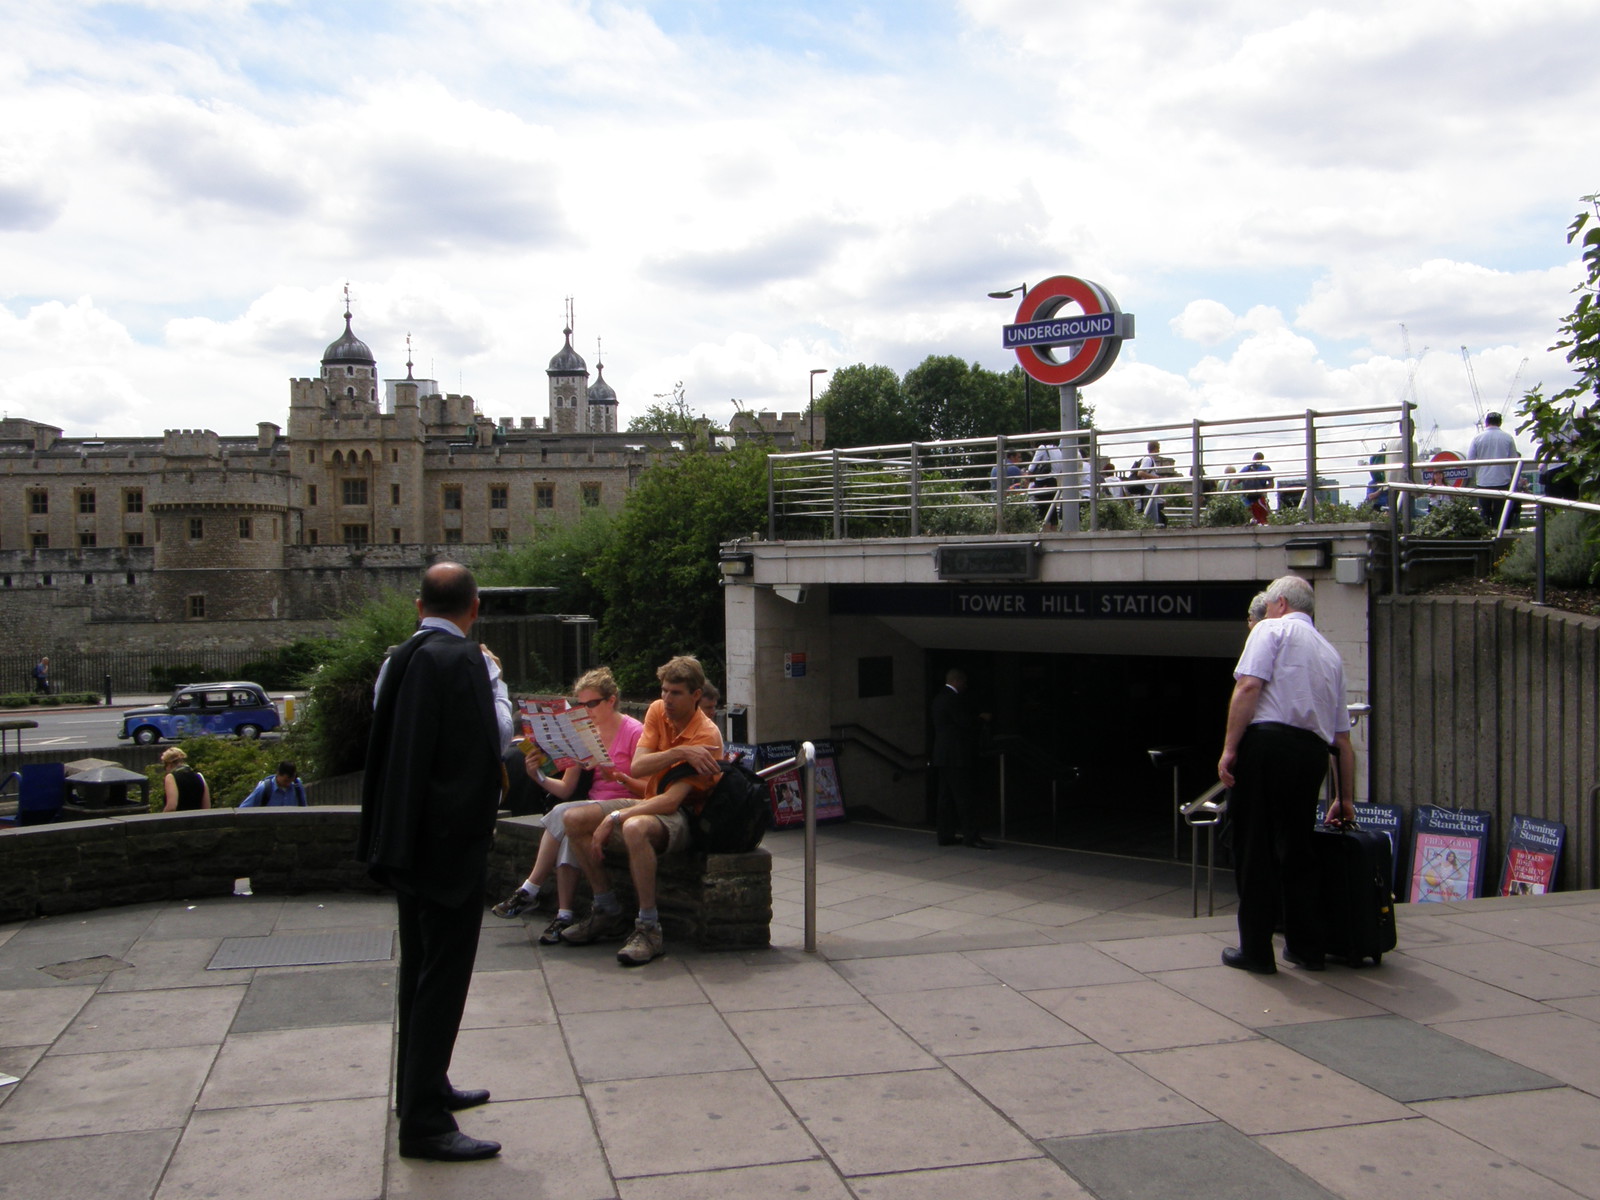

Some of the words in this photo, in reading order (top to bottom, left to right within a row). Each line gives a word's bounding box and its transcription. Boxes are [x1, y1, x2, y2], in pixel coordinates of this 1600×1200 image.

[1008, 318, 1112, 342] UNDERGROUND
[959, 594, 1026, 613] TOWER
[1042, 595, 1085, 613] HILL
[1101, 594, 1193, 614] STATION
[1352, 805, 1393, 818] vening
[1431, 809, 1480, 824] Evening
[1428, 819, 1485, 833] Standard
[1522, 819, 1558, 838] Evening
[1519, 829, 1560, 847] Standard
